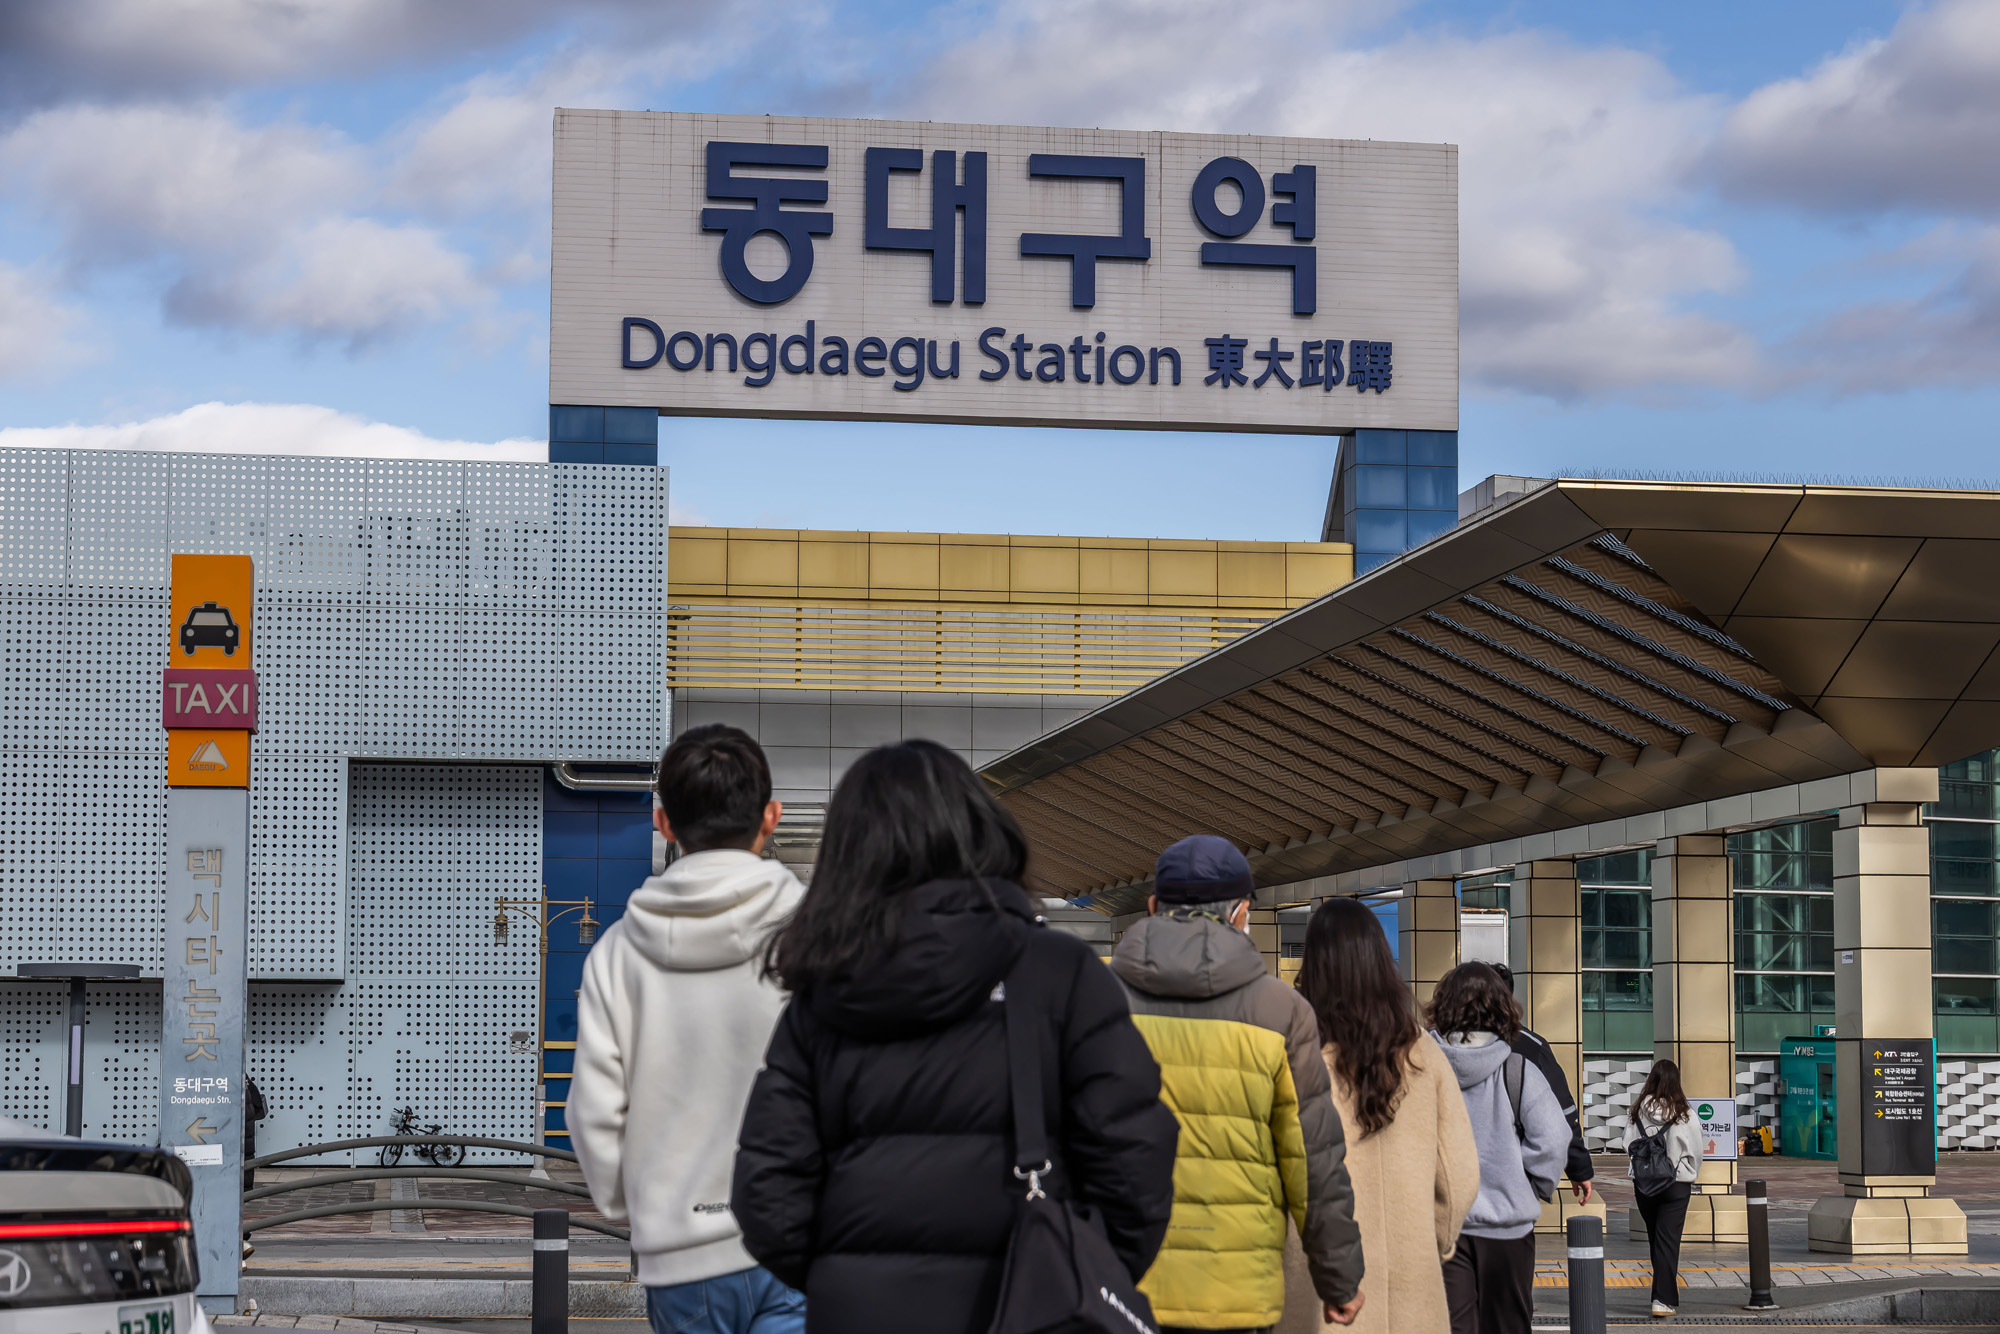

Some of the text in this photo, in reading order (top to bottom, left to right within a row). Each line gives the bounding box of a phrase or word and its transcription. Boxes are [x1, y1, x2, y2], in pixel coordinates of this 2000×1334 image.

[701, 141, 1317, 316] 동대구역
[621, 316, 1394, 394] Dongdaegu Station 東大邱驛
[168, 682, 249, 715] TAXI
[188, 763, 216, 771] DAEGU
[173, 1077, 228, 1093] 동대구역
[170, 1095, 232, 1105] Dongdaegu Stn.
[1710, 1123, 1731, 1132] 가는길
